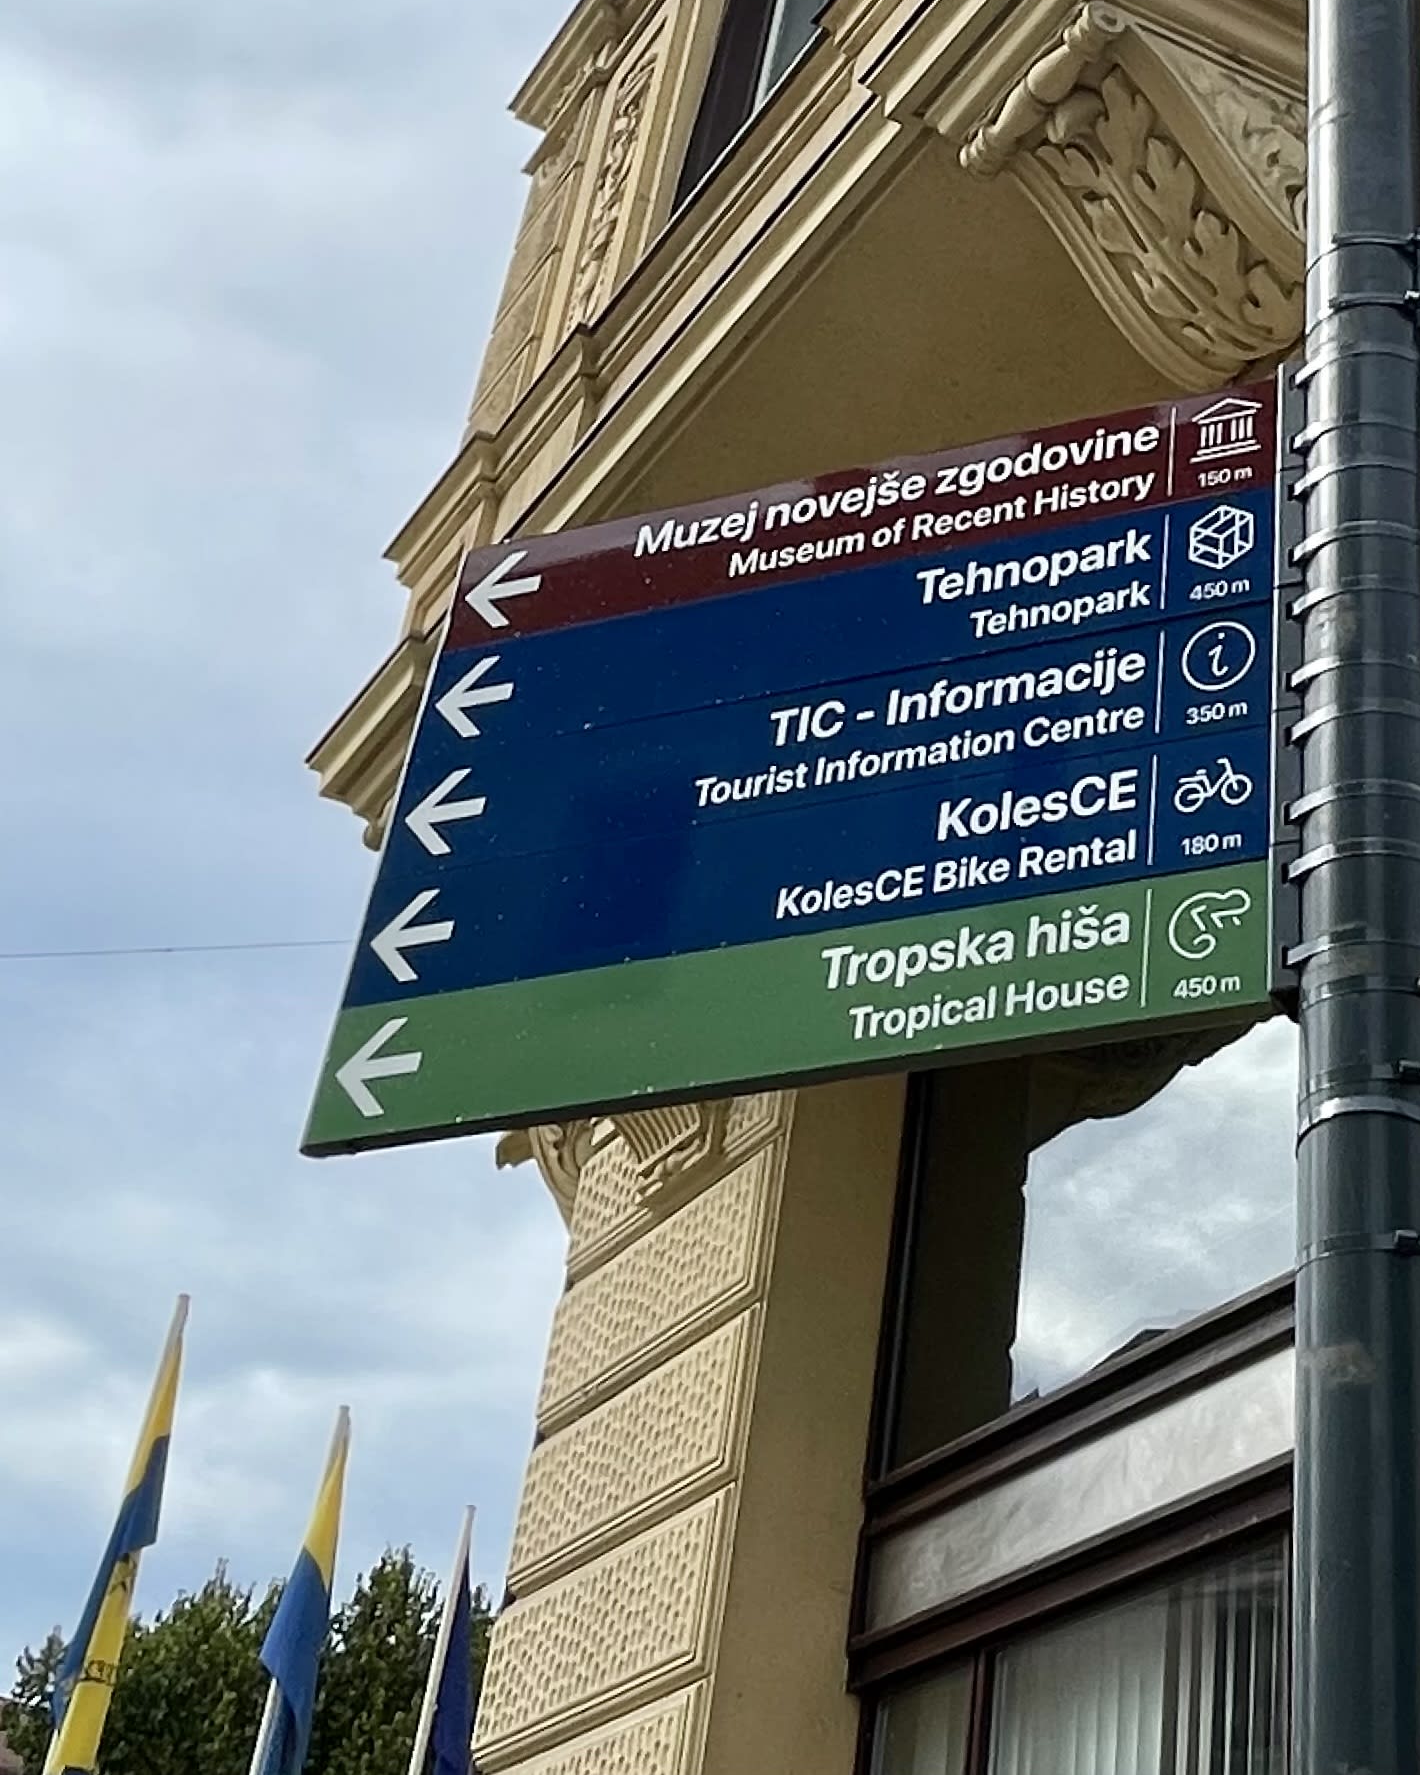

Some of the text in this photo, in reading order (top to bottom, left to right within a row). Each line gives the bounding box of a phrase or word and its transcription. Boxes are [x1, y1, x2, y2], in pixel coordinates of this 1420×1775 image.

[633, 426, 1160, 557] Muzej novejše zgodovine
[1198, 466, 1253, 488] 150 m
[728, 472, 1155, 578] Museum of Recent History
[916, 529, 1152, 604] Tehnopark
[1189, 579, 1250, 600] 450 m
[969, 580, 1151, 638] Tehnopark
[770, 647, 1146, 747] TIC - Informacije
[1186, 702, 1248, 725] 350 m
[695, 706, 1145, 807] Tourist Information Centre
[937, 768, 1138, 842] KolesCE
[776, 829, 1137, 919] KolesCE Bike Rental
[1181, 833, 1242, 855] 180 m
[821, 904, 1130, 989] Tropska hiša
[848, 974, 1130, 1039] Tropical House
[1173, 975, 1241, 999] 450 m
